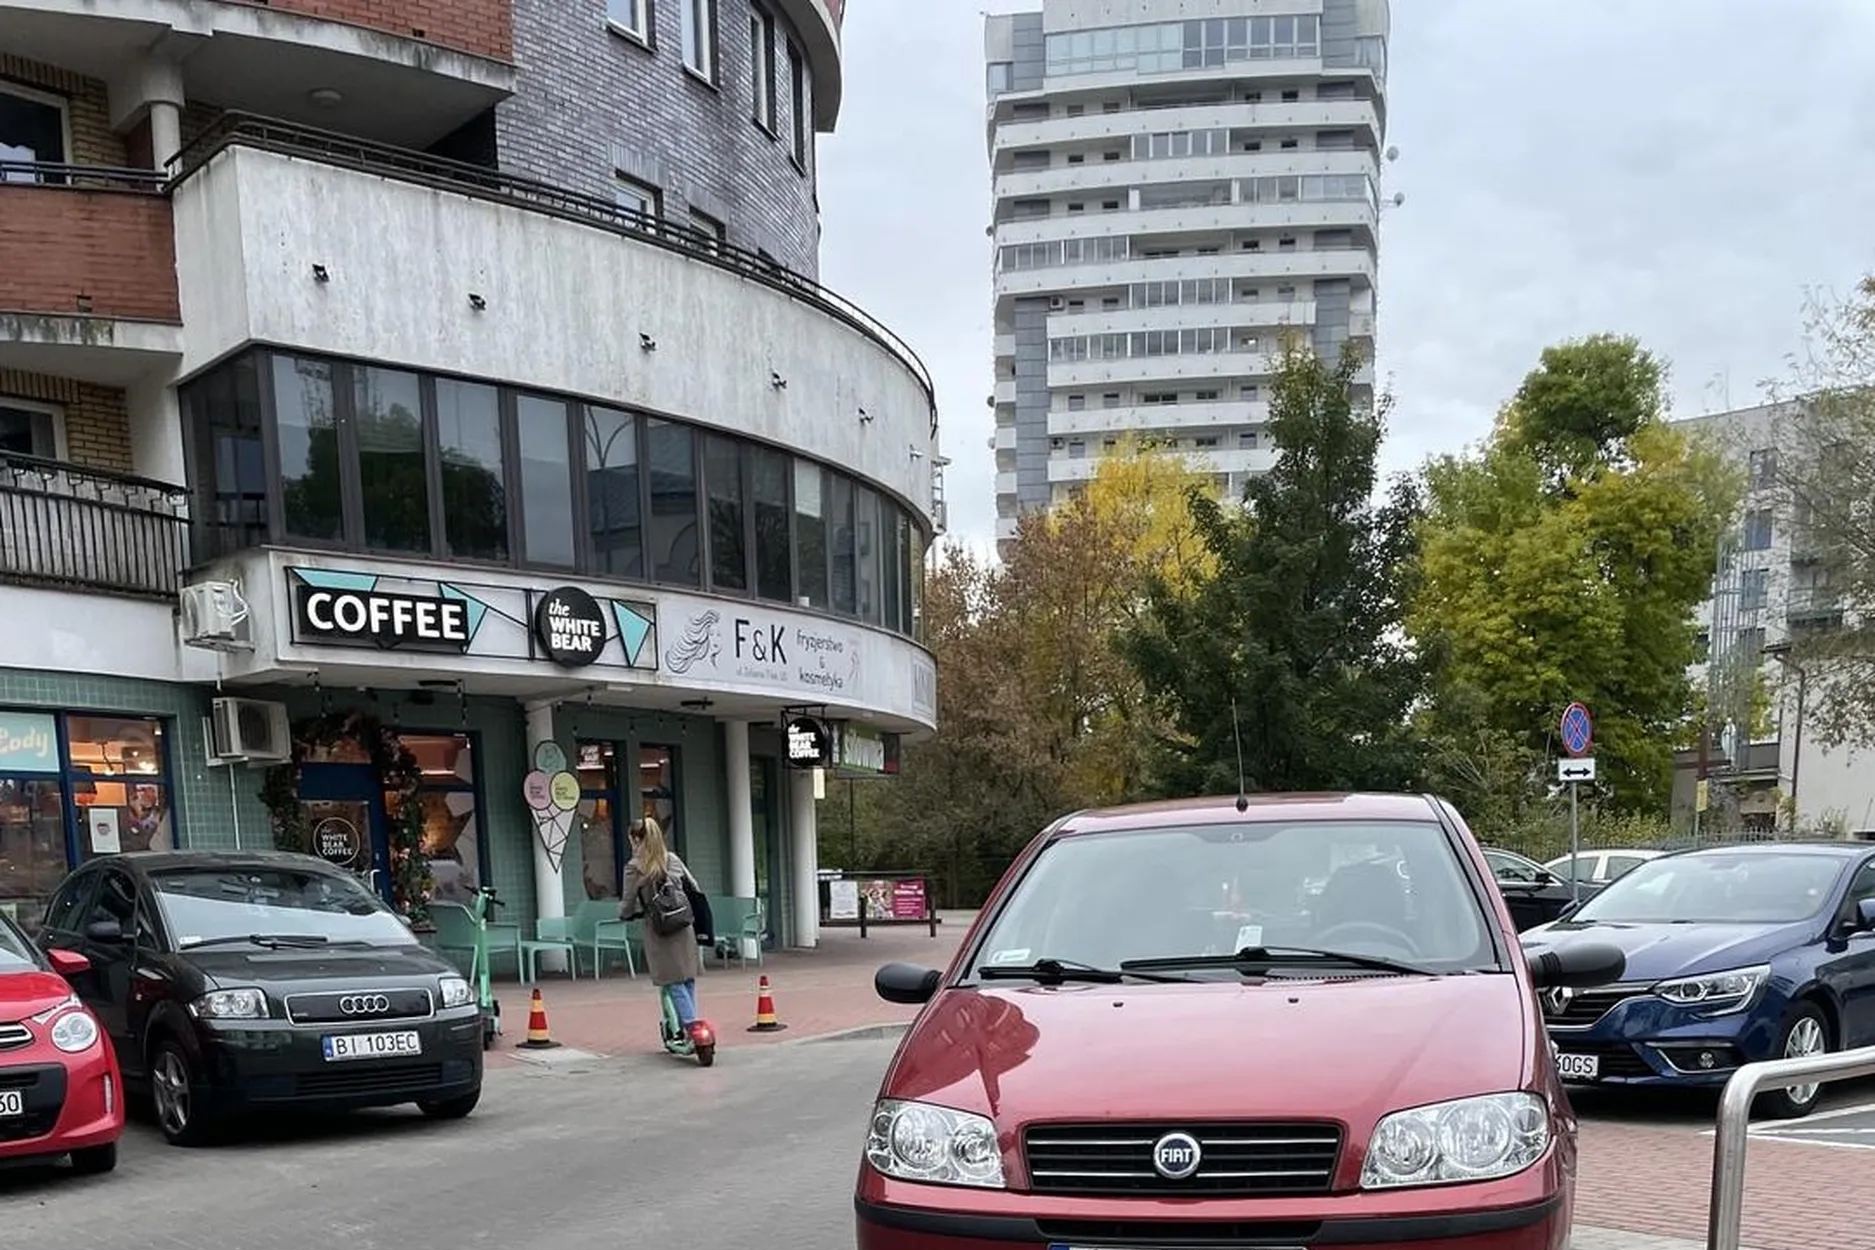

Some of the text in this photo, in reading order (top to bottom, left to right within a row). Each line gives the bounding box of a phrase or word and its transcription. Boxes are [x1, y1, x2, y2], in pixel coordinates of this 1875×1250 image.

[306, 592, 466, 640] COFFEE
[548, 597, 570, 617] the
[549, 616, 600, 637] WHITE
[550, 633, 592, 652] BEAR
[799, 667, 843, 691] kosmetyka
[366, 1033, 417, 1052] 103EC
[1160, 1147, 1192, 1163] FIAT
